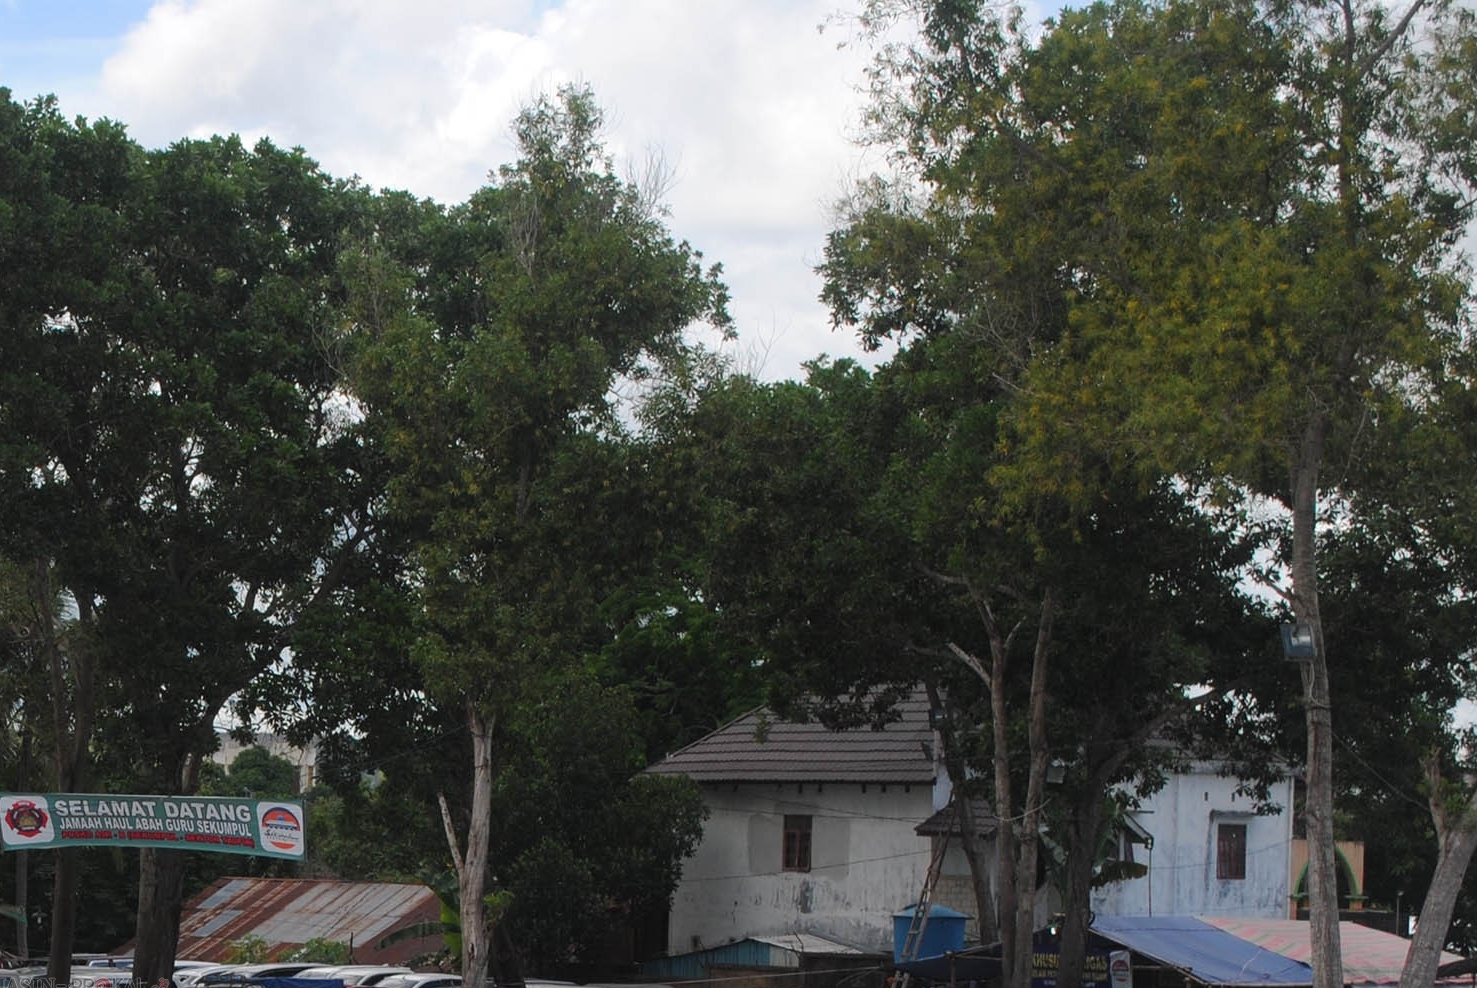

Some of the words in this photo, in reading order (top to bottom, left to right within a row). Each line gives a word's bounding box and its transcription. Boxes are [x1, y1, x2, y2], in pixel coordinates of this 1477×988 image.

[55, 800, 156, 818] SELAMAT
[164, 802, 251, 822] DATANG
[60, 817, 101, 830] JAMAAH
[105, 818, 132, 831] HAUL
[135, 819, 164, 832] ABAH
[166, 820, 194, 833] GURU
[197, 821, 252, 837] SEKUMPUL
